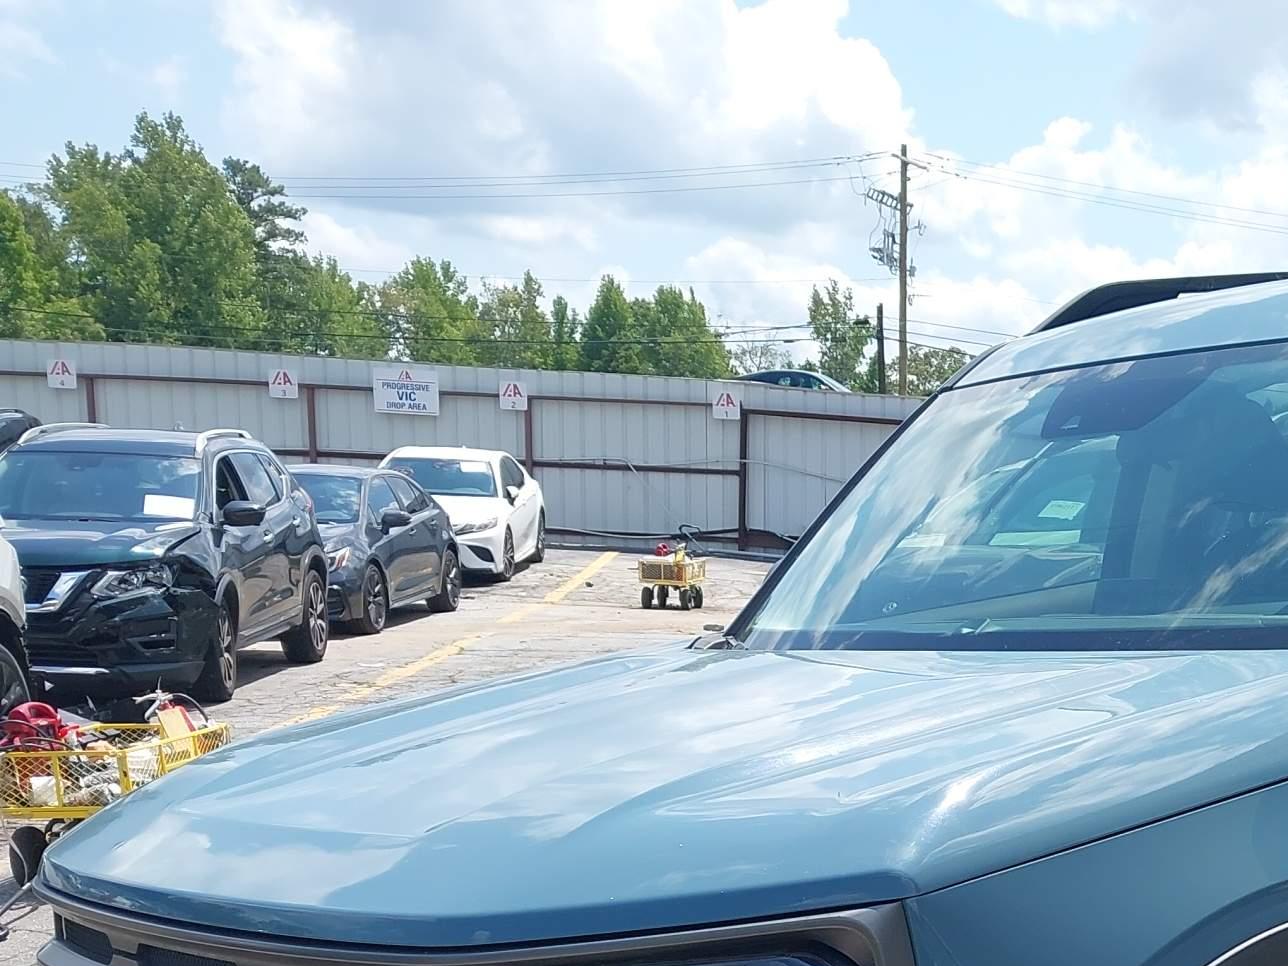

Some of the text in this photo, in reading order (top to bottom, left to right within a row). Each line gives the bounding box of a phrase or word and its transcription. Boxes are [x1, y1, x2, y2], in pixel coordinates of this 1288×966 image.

[381, 381, 432, 391] PROGRESSIVE
[397, 391, 417, 402] VIC
[386, 401, 428, 411] DROP AREA
[511, 401, 517, 409] 2
